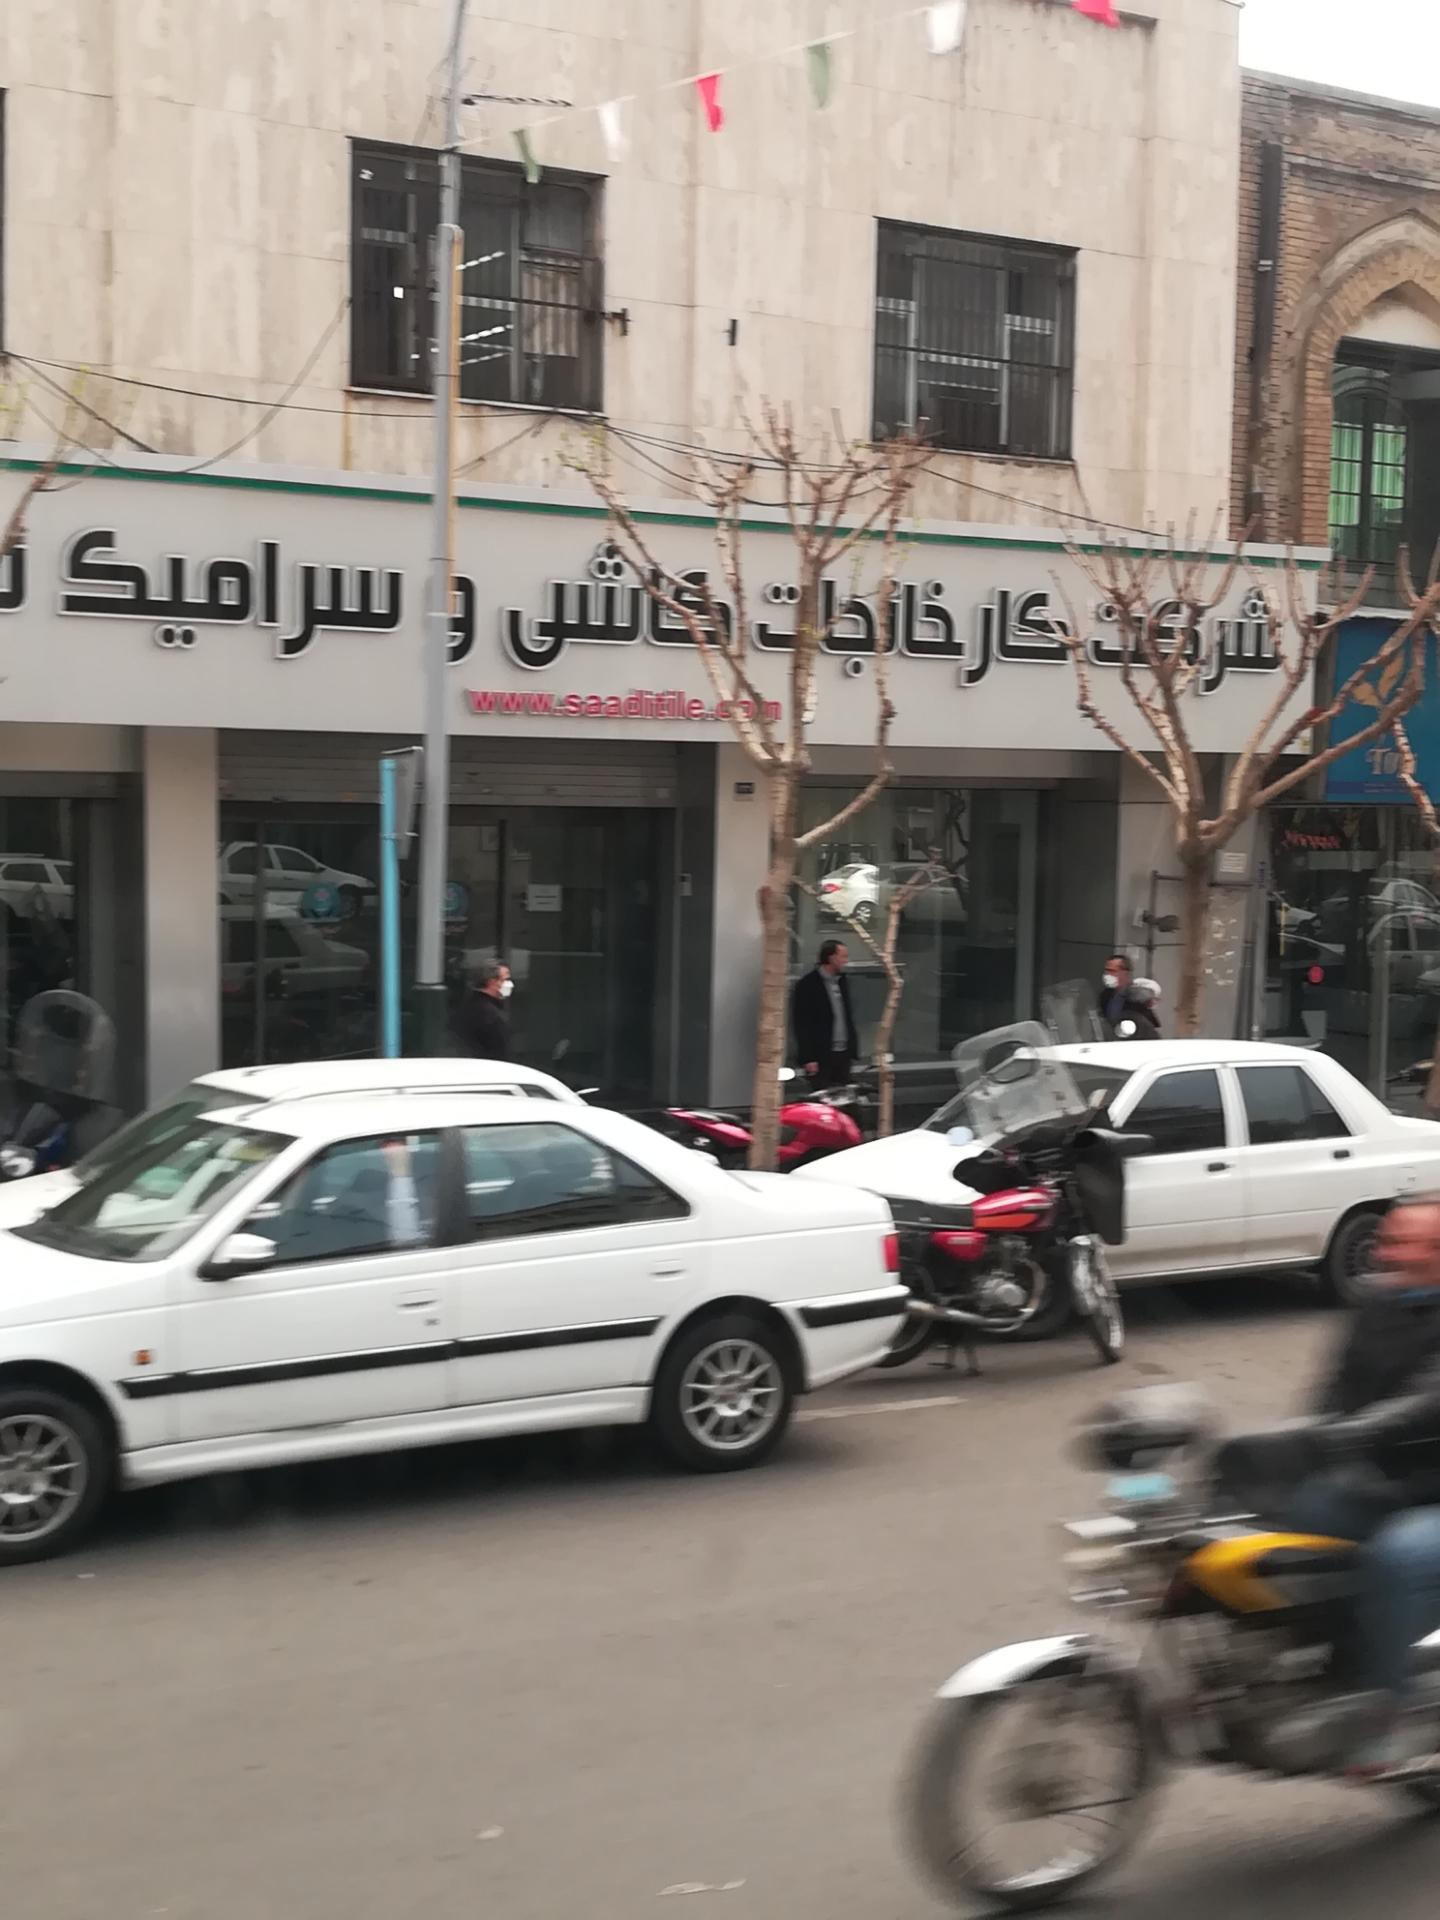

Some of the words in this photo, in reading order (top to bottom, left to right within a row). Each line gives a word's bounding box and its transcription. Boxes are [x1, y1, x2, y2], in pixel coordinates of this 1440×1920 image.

[59, 528, 405, 660] سرامیک
[445, 572, 478, 666] و
[502, 542, 735, 671] کاشی
[752, 575, 1070, 688] کارخانجات
